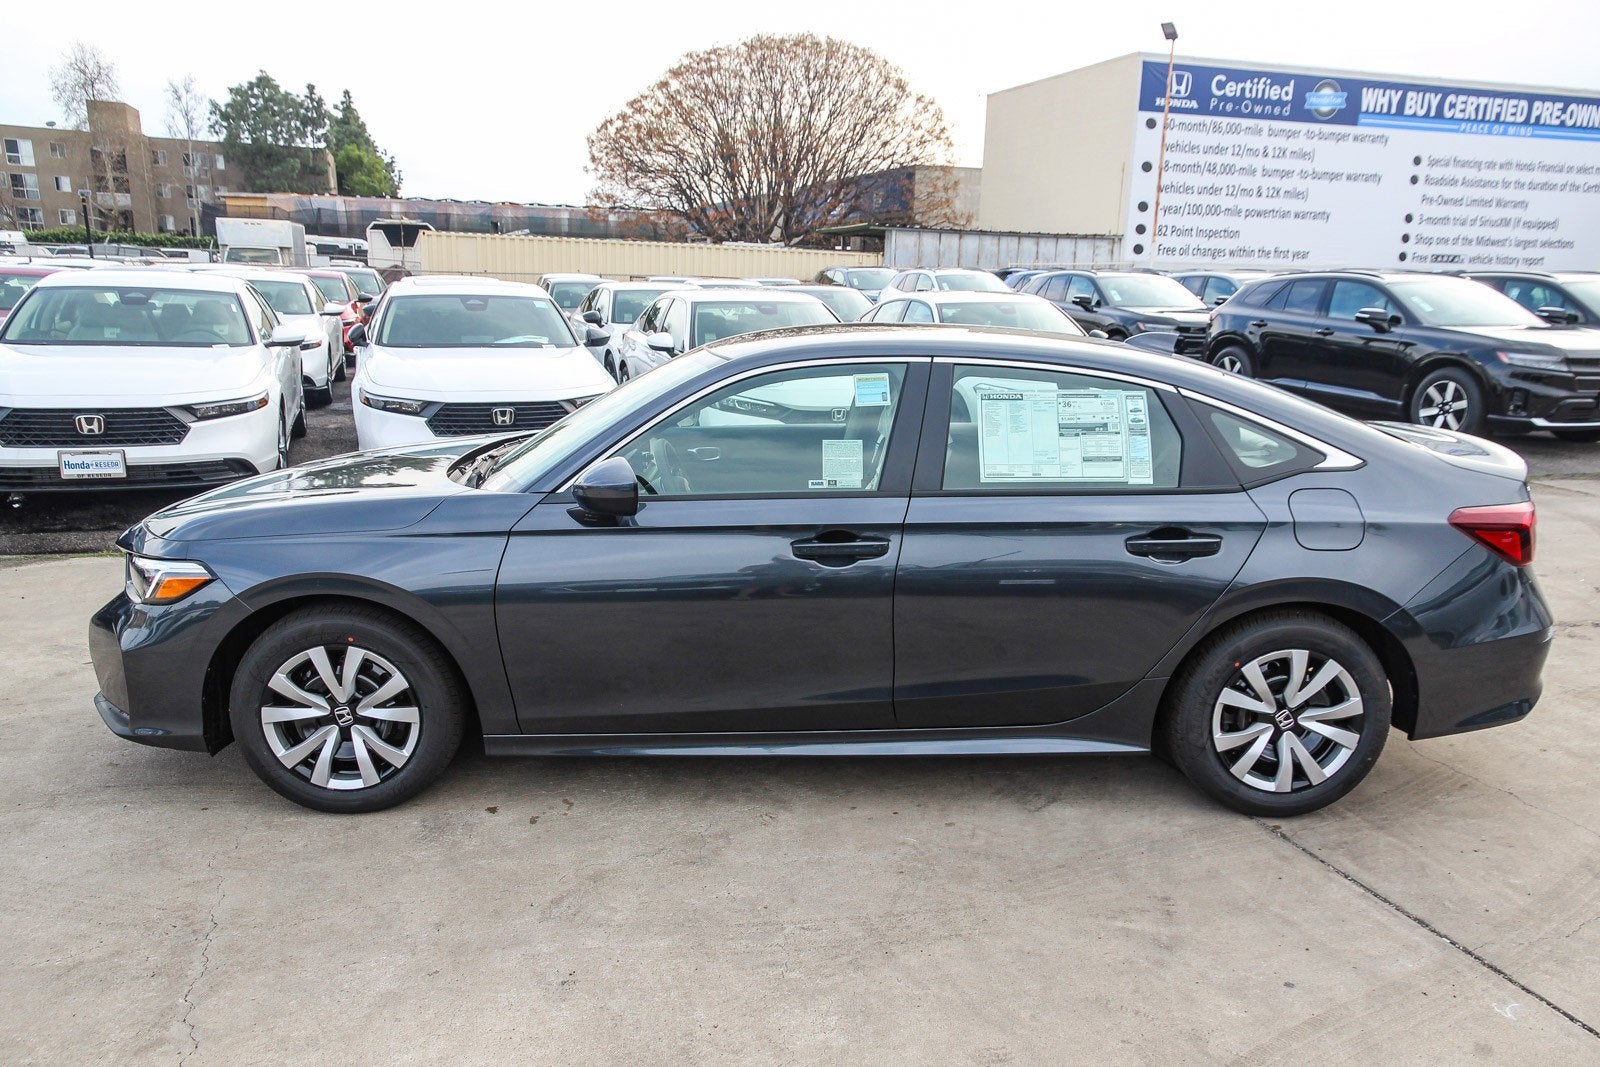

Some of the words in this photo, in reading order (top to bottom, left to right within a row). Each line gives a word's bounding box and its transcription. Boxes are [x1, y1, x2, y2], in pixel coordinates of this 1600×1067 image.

[1211, 74, 1295, 101] Certified
[1210, 97, 1292, 116] Pre-Owned
[1361, 87, 1403, 114] WHY
[1403, 91, 1442, 117] BUY
[1443, 94, 1528, 123] CERTIFIED
[1267, 124, 1301, 141] bumper
[1352, 132, 1390, 148] warranty
[1459, 122, 1489, 133] PEACE
[1491, 124, 1505, 135] OF
[1507, 126, 1533, 136] MIND
[1202, 143, 1229, 155] under
[1231, 143, 1260, 158] 12/mo
[1262, 145, 1269, 158] &
[1271, 146, 1287, 159] 12K
[1427, 155, 1451, 168] Special
[1452, 156, 1483, 172] financing
[1499, 159, 1513, 170] with
[1514, 160, 1536, 172] Honda
[1537, 161, 1566, 173] Financial
[1161, 160, 1257, 177] 8-month/48,000-mile
[1261, 164, 1295, 181] bumper
[1345, 172, 1383, 186] warranty
[1197, 183, 1223, 196] under
[1225, 183, 1254, 198] 12/mo
[1256, 185, 1263, 198] &
[1265, 186, 1282, 199] 12K
[1424, 174, 1460, 187] Roadside
[1460, 176, 1500, 189] Assistance
[1513, 178, 1526, 190] the
[1527, 179, 1558, 191] duration
[1559, 180, 1568, 191] of
[1568, 181, 1581, 192] the
[1421, 194, 1464, 207] Pre-Owned
[1465, 195, 1494, 208] Limited
[1494, 197, 1529, 211] Warranty
[1159, 202, 1243, 218] -year/100,000-mile
[1293, 210, 1331, 223] warranty
[1418, 213, 1451, 226] 3-month
[1452, 214, 1468, 226] trial
[1469, 215, 1479, 227] of
[1156, 224, 1169, 237] 82
[1170, 225, 1193, 238] Point
[1195, 226, 1241, 241] Inspection
[1414, 233, 1435, 247] Shop
[1436, 236, 1450, 246] one
[1451, 235, 1461, 246] of
[1461, 236, 1474, 246] the
[1157, 244, 1177, 257] Free
[1178, 244, 1190, 256] oil
[1191, 245, 1226, 260] changes
[1228, 246, 1255, 259] within
[1257, 247, 1271, 259] the
[1273, 247, 1290, 259] first
[1291, 249, 1311, 261] year
[1411, 251, 1429, 263] Free
[63, 460, 91, 470] Honda
